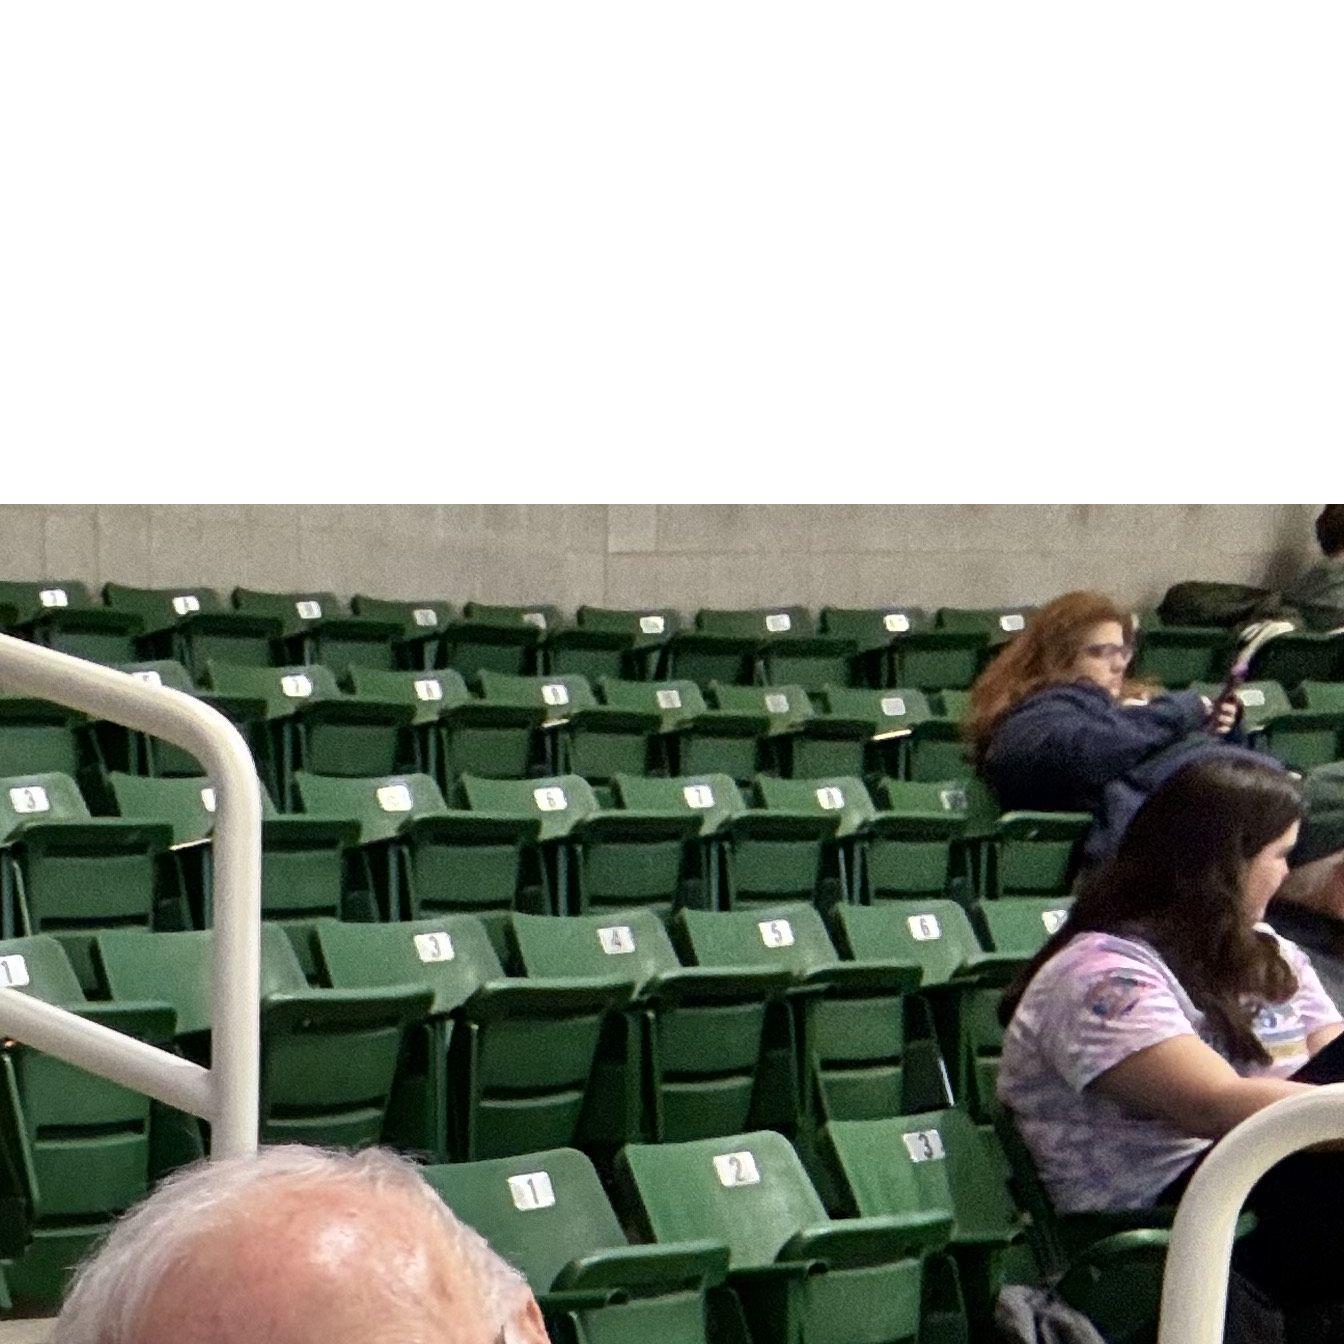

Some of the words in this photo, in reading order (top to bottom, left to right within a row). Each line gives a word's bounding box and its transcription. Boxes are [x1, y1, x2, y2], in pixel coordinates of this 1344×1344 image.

[24, 788, 36, 810] 3
[545, 790, 558, 809] 6
[694, 788, 704, 806] 7
[770, 921, 784, 944] 5
[918, 916, 931, 937] 6
[428, 934, 442, 959] 3
[610, 929, 623, 950] 4
[0, 959, 14, 985] 1
[917, 1132, 934, 1160] 3
[728, 1155, 746, 1182] 2
[526, 1177, 541, 1205] 1
